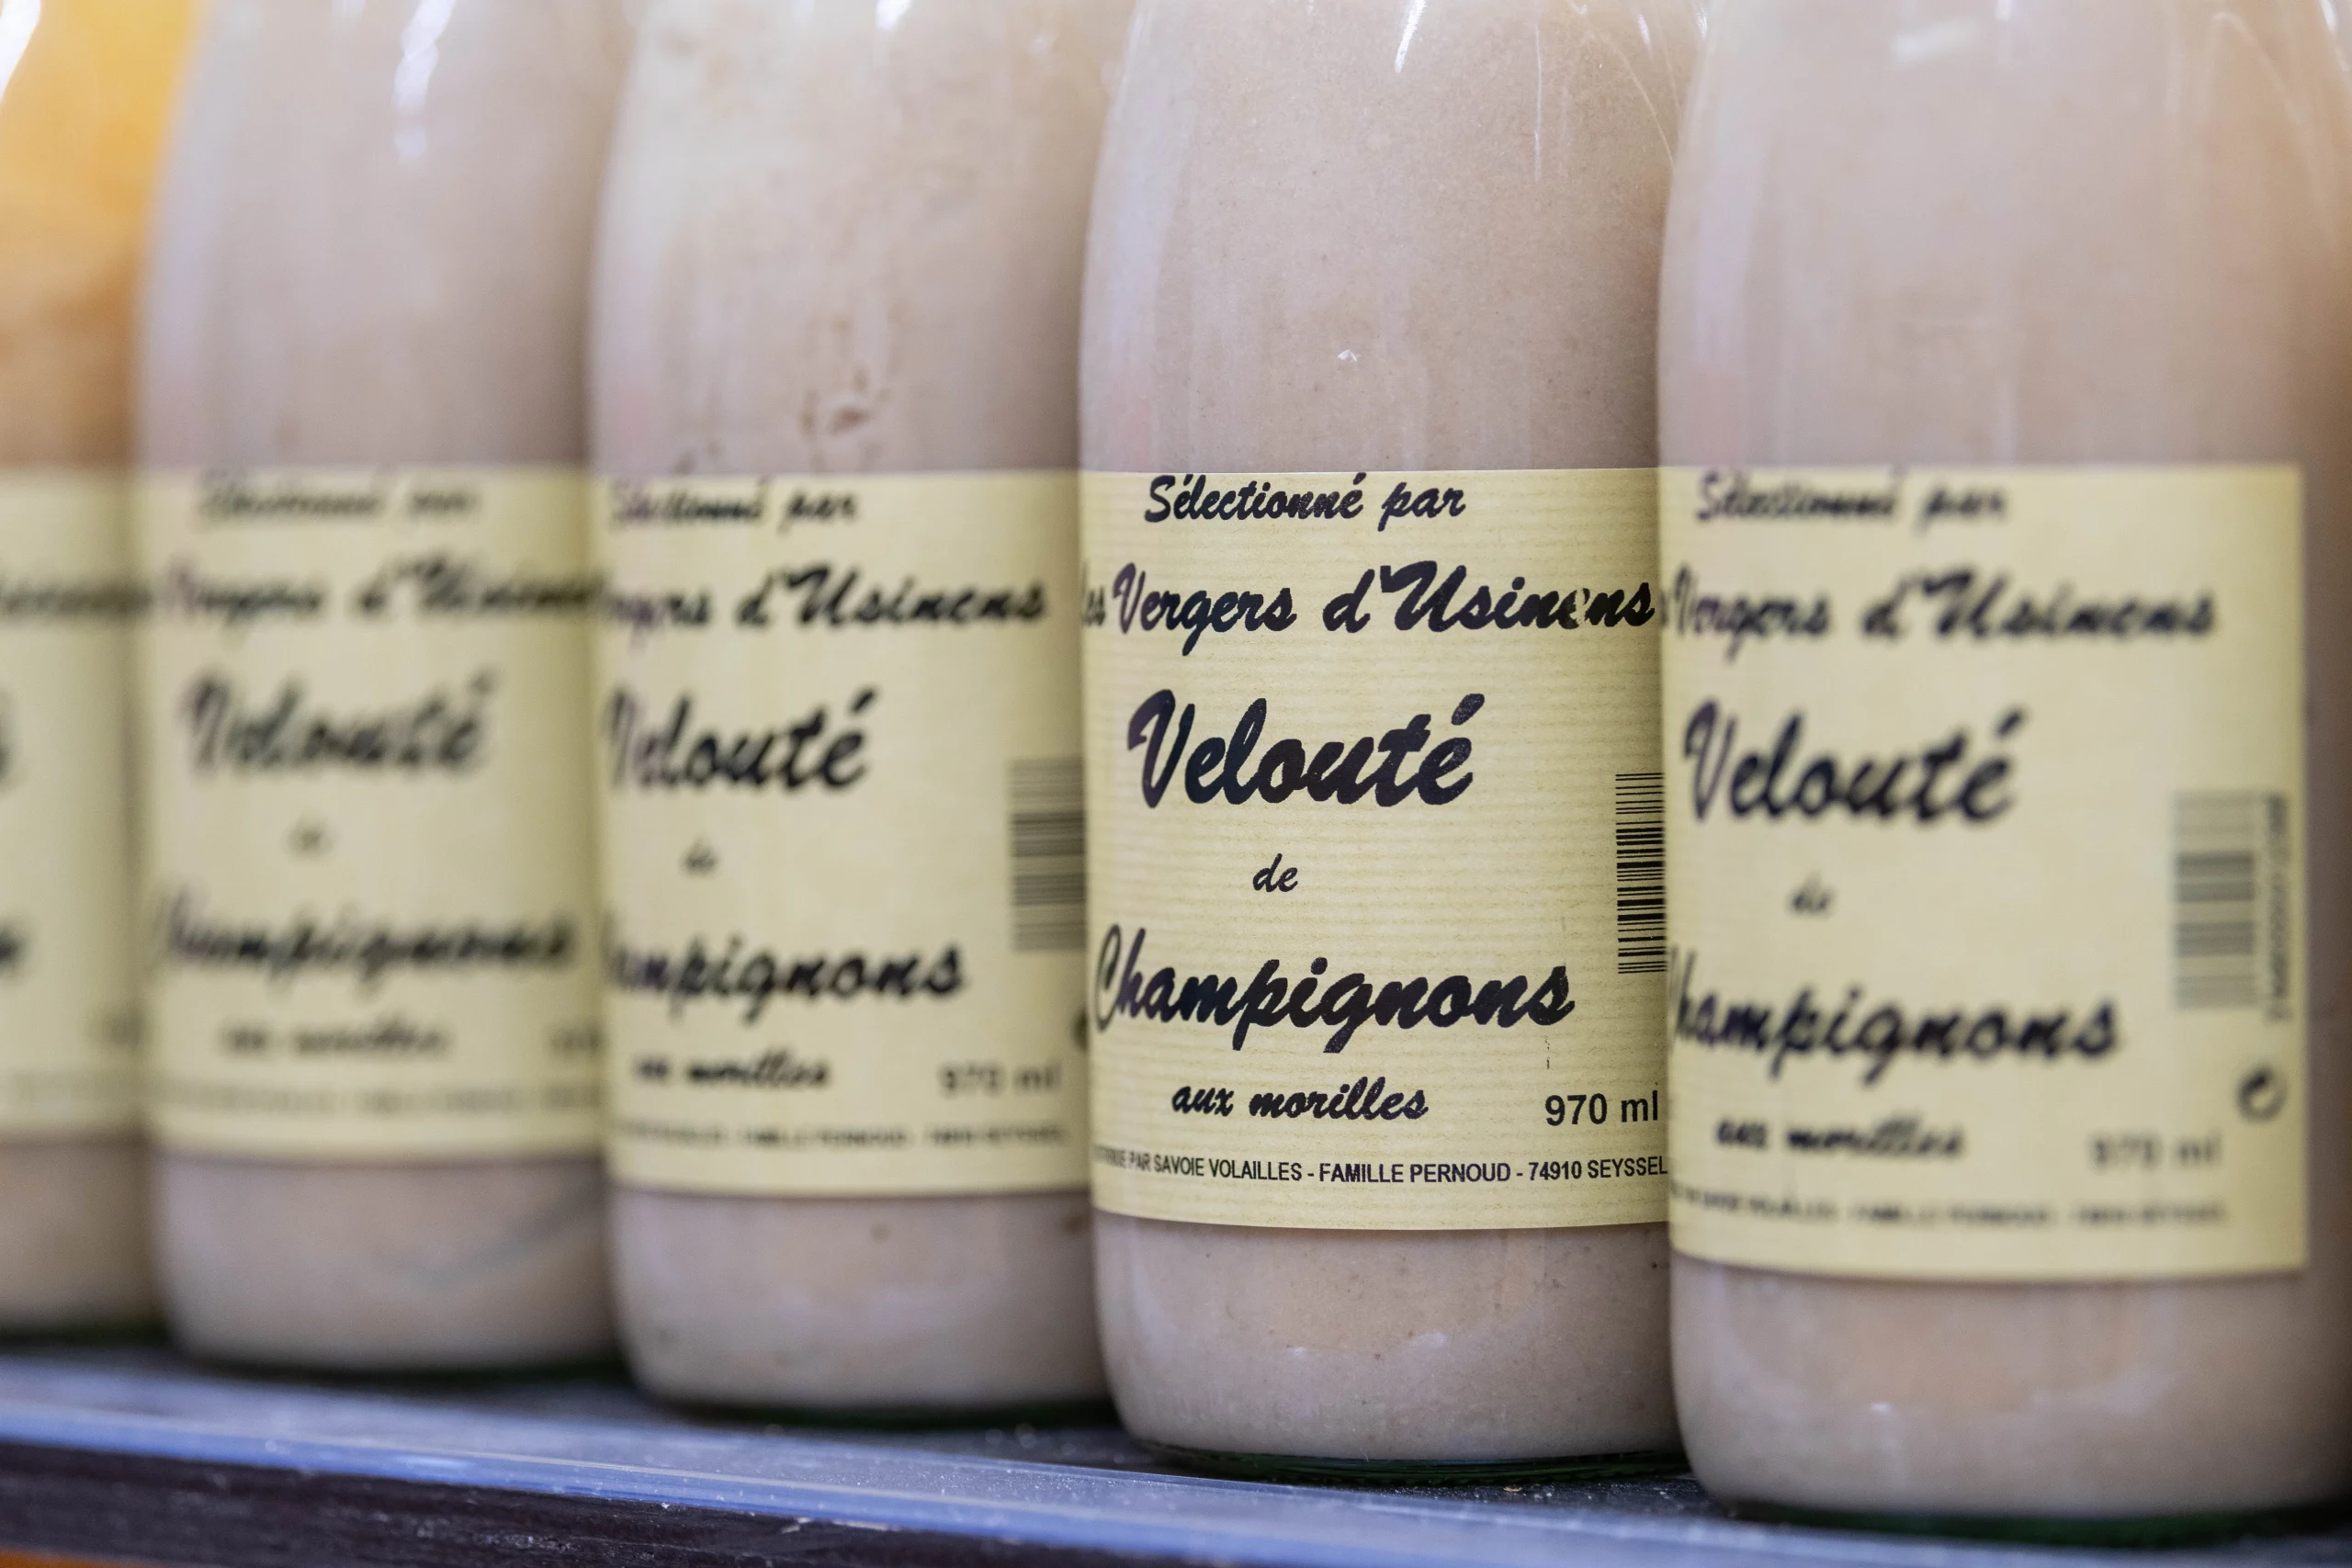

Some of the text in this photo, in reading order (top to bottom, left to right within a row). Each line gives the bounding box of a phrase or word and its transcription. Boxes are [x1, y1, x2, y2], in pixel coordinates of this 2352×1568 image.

[1144, 472, 1466, 532] Sélectionné par
[1113, 563, 1297, 656] Vergers
[1127, 689, 1485, 808] Velouté
[1681, 698, 2029, 826] Velouté
[1252, 853, 1298, 892] de
[1096, 925, 1575, 1054] Champignons
[1668, 944, 2122, 1089] hampignons
[1171, 1077, 1429, 1121] aux morilles
[1545, 1090, 1657, 1126] 970 ml
[1153, 1154, 1204, 1177] SAVOIE
[1208, 1159, 1302, 1181] VOLAILLES
[1319, 1163, 1403, 1182] FAMILLE
[1410, 1163, 1510, 1182] PERNOUD
[1529, 1161, 1582, 1180] 74910
[1587, 1156, 1668, 1179] SEYSSEL
